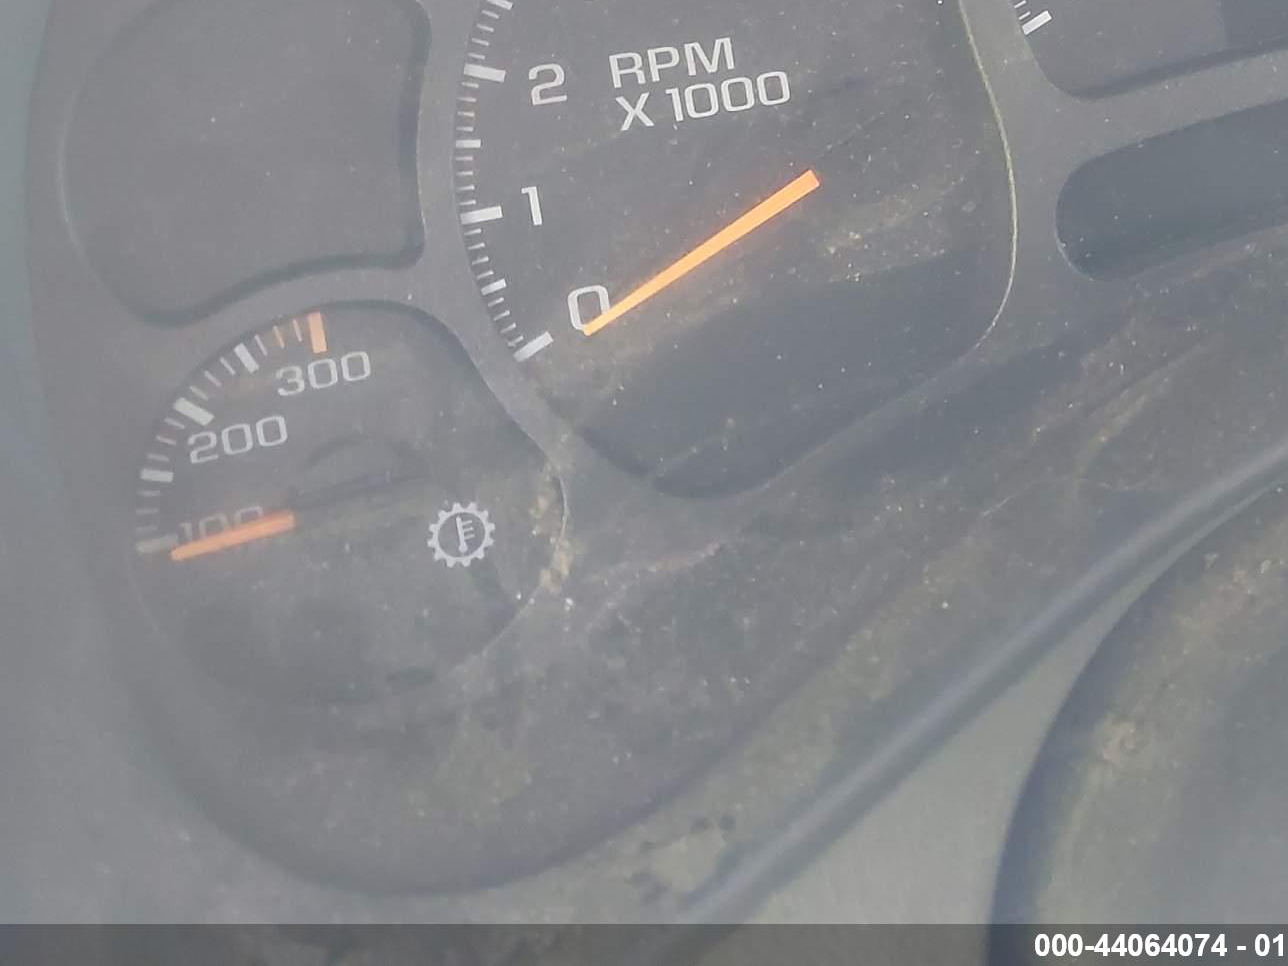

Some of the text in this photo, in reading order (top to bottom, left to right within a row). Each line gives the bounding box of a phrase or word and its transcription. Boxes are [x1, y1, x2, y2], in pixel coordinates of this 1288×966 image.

[529, 64, 567, 105] 2
[609, 37, 735, 87] RPM
[616, 71, 790, 131] X 1000
[521, 186, 542, 225] 1
[567, 285, 611, 331] 0
[276, 351, 371, 396] 300
[188, 416, 288, 463] 200
